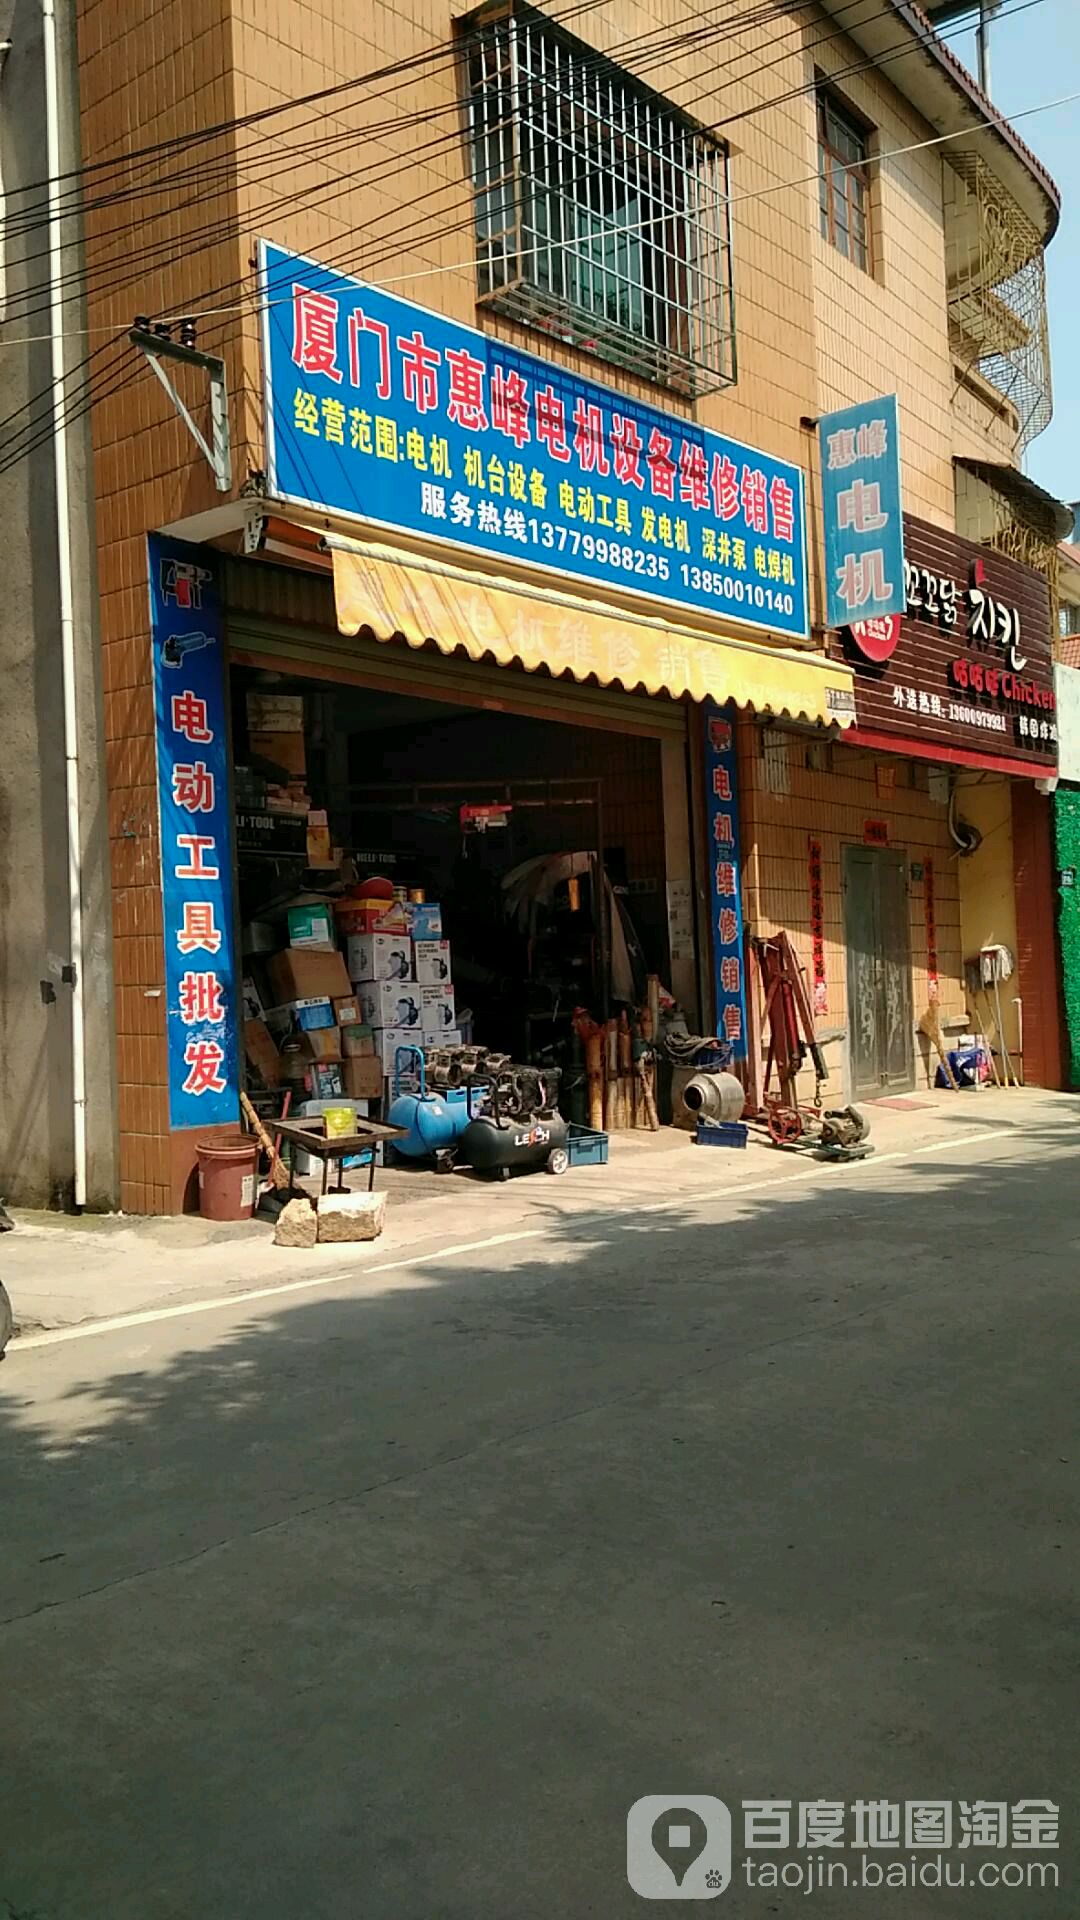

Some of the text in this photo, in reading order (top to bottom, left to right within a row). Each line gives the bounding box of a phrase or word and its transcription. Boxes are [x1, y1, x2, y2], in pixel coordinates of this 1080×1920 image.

[291, 283, 796, 543] 厦门市惠峰电机设备维修销售
[826, 419, 888, 471] 惠峰
[463, 445, 548, 510] 机台设备
[559, 479, 632, 536] 电动工具
[641, 504, 691, 554] 发电机
[702, 526, 747, 572] 深井泵
[753, 544, 796, 586] 电焊机
[836, 478, 893, 609] 电机
[680, 563, 794, 616] 13850010140
[969, 558, 1028, 672] 치킨
[169, 688, 228, 1095] 电动工具批发
[712, 763, 743, 1041] 电机维修销售
